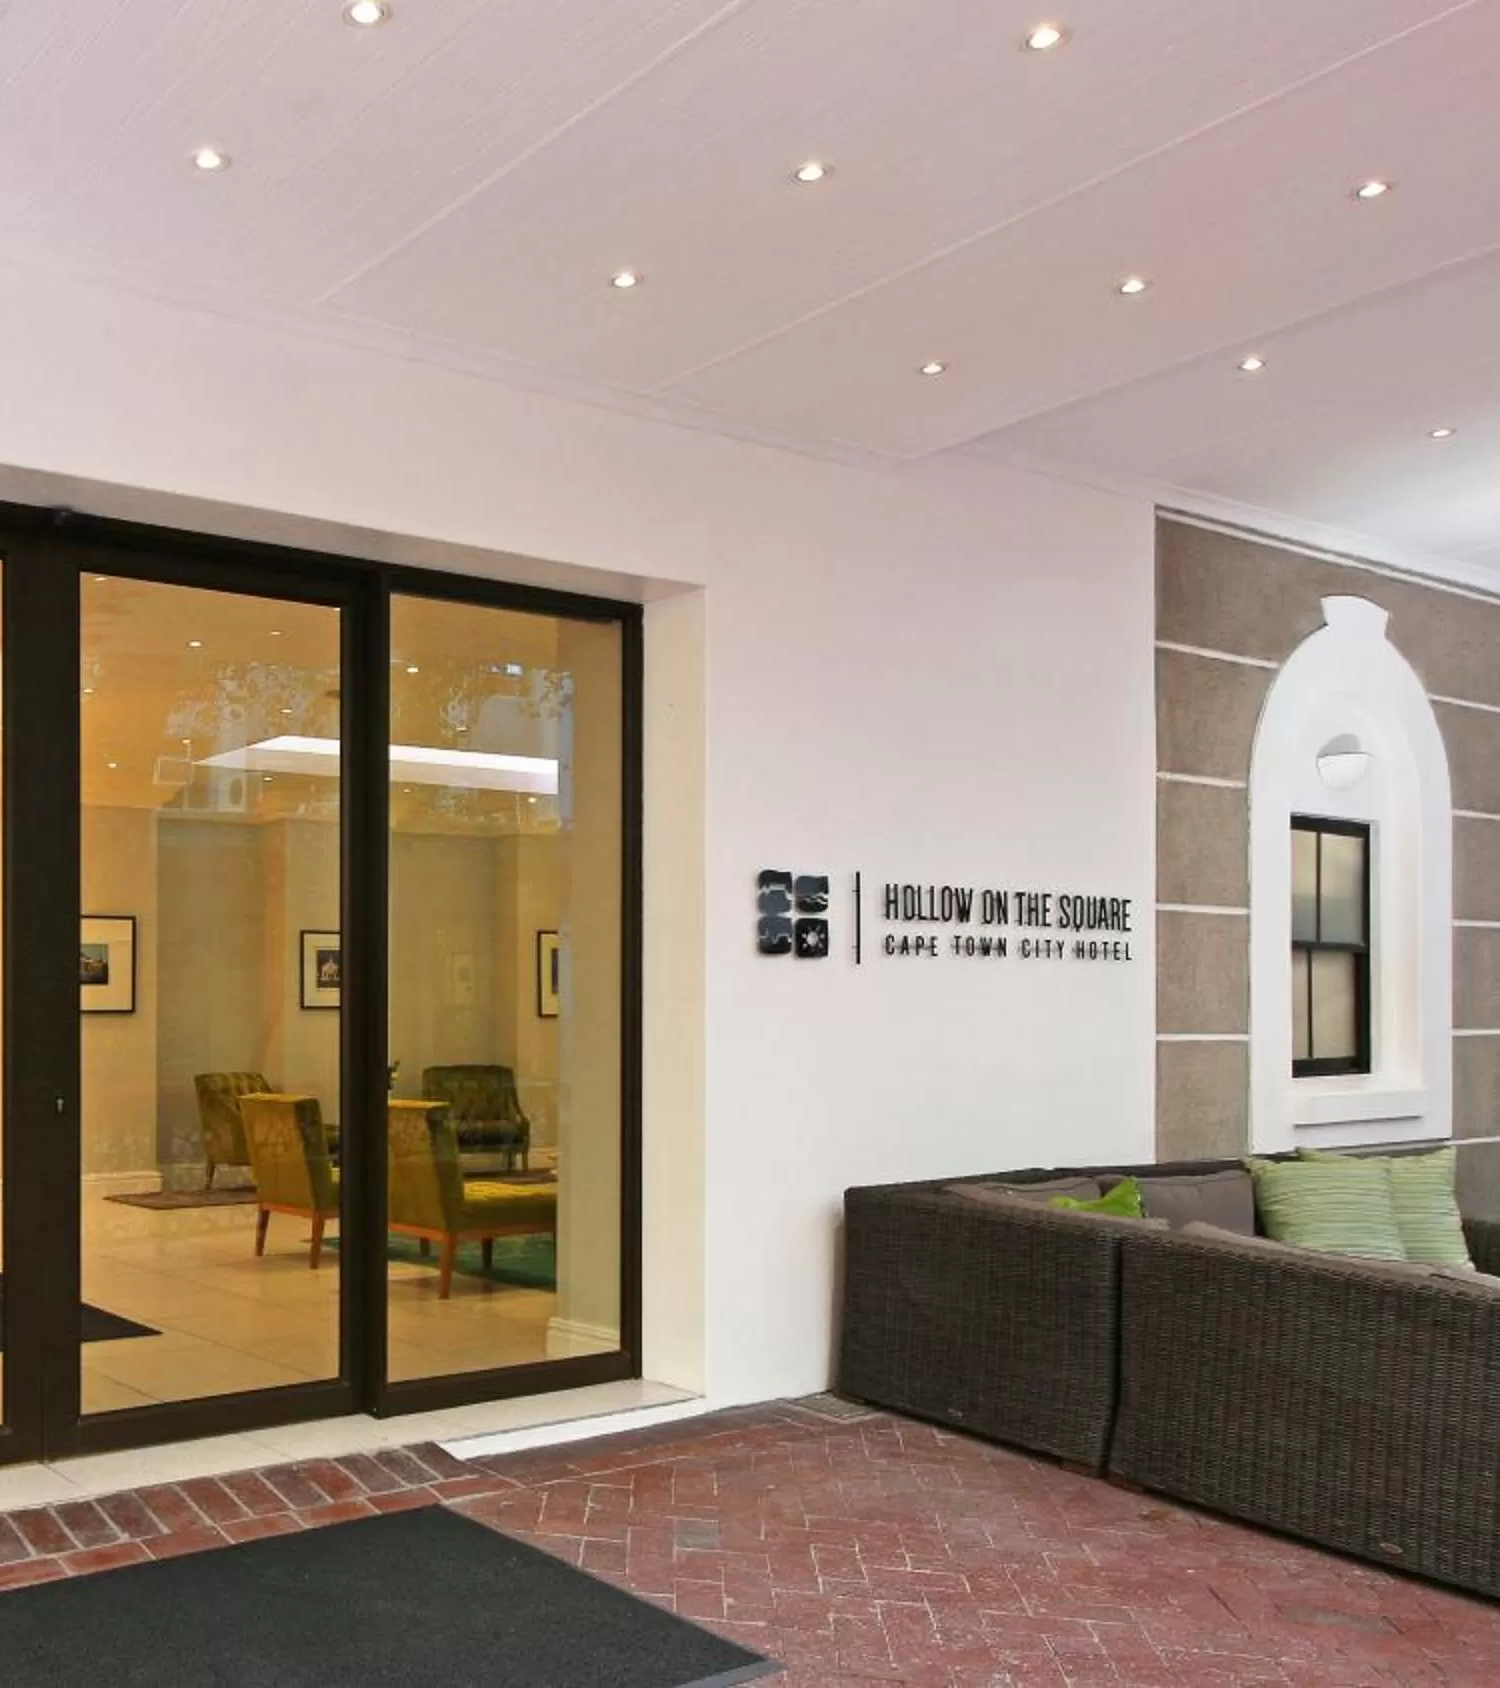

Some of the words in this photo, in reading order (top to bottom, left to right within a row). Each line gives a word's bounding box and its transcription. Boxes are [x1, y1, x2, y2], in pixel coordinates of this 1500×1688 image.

[884, 883, 973, 923] HOLLOW
[981, 889, 1008, 925] ON
[1014, 891, 1052, 927] THE
[1059, 894, 1132, 932] SQUARE
[885, 934, 938, 957] CAPE
[953, 935, 1006, 957] TOWN
[1020, 938, 1065, 960] CITY
[1074, 941, 1132, 961] HOTEL
